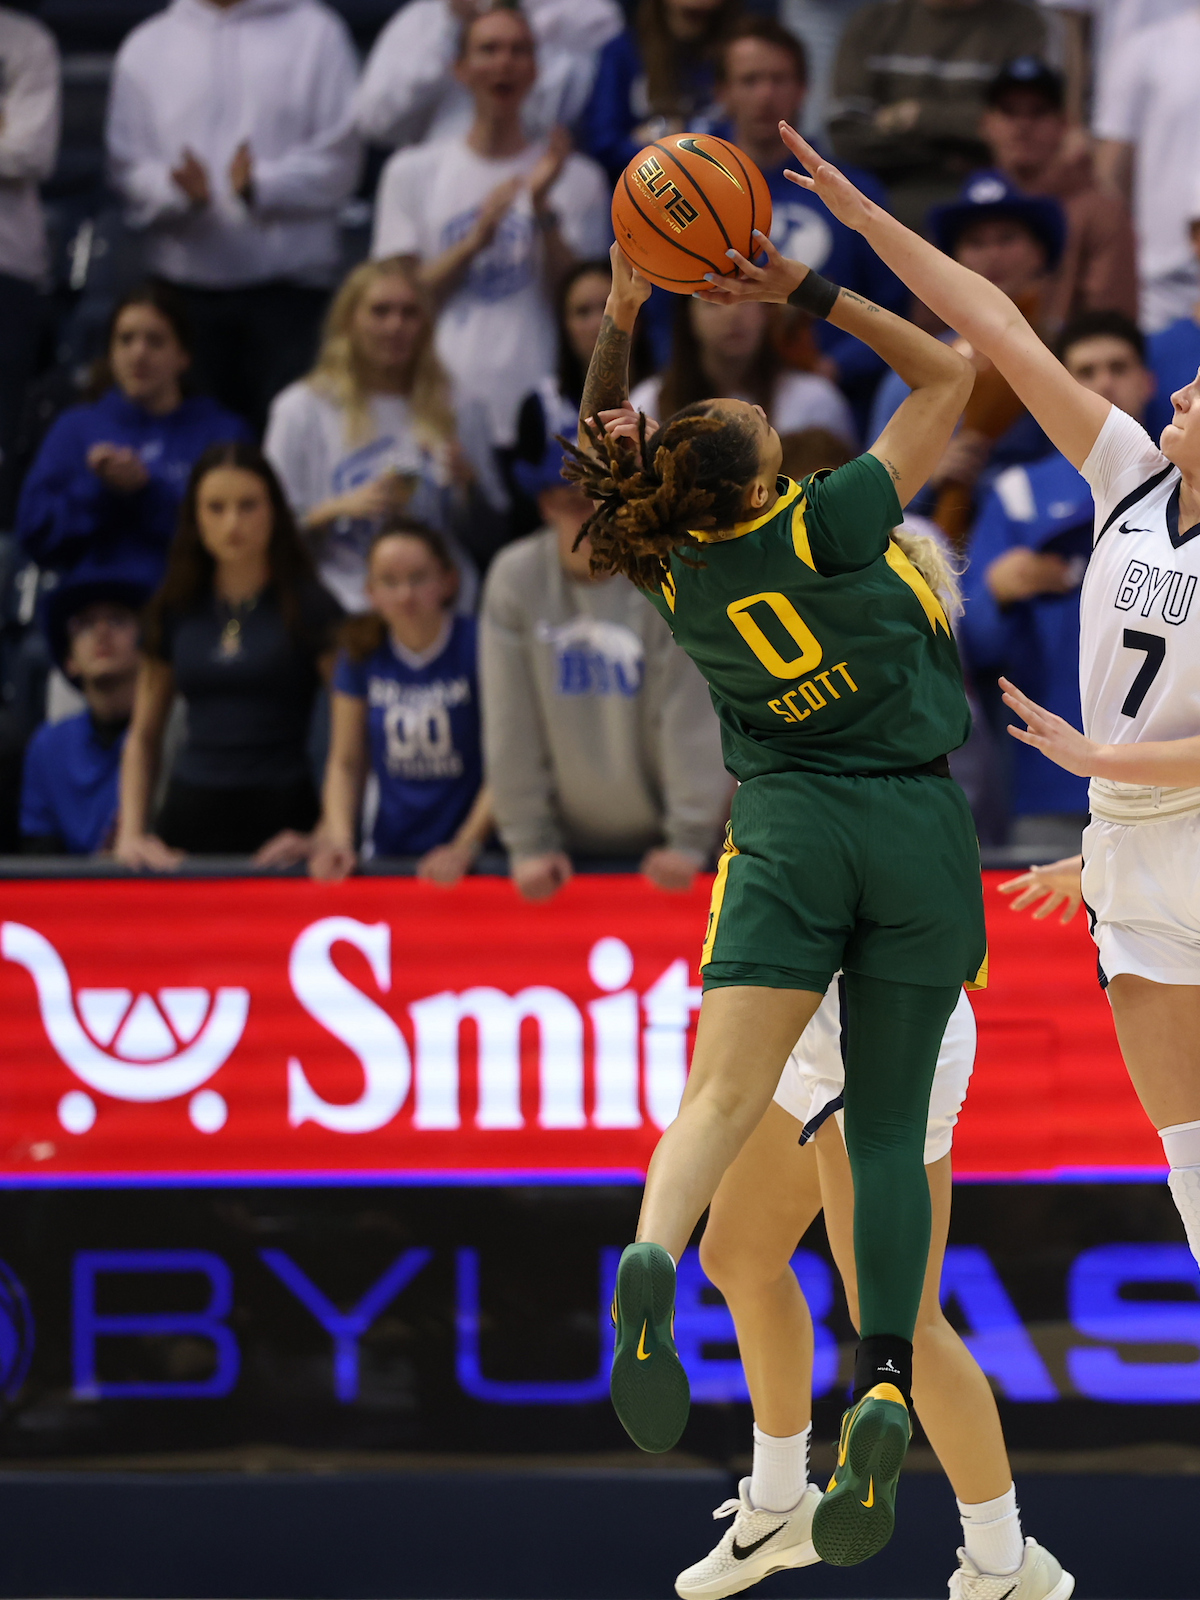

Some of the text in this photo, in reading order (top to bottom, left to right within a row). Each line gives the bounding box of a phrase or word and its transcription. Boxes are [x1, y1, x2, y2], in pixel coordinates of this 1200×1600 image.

[631, 172, 682, 234] CHAMPIONSHIP
[636, 155, 700, 231] ELITE
[1114, 559, 1198, 626] BYU
[726, 591, 823, 680] 0
[767, 661, 860, 723] SCOTT
[1121, 628, 1166, 719] 7
